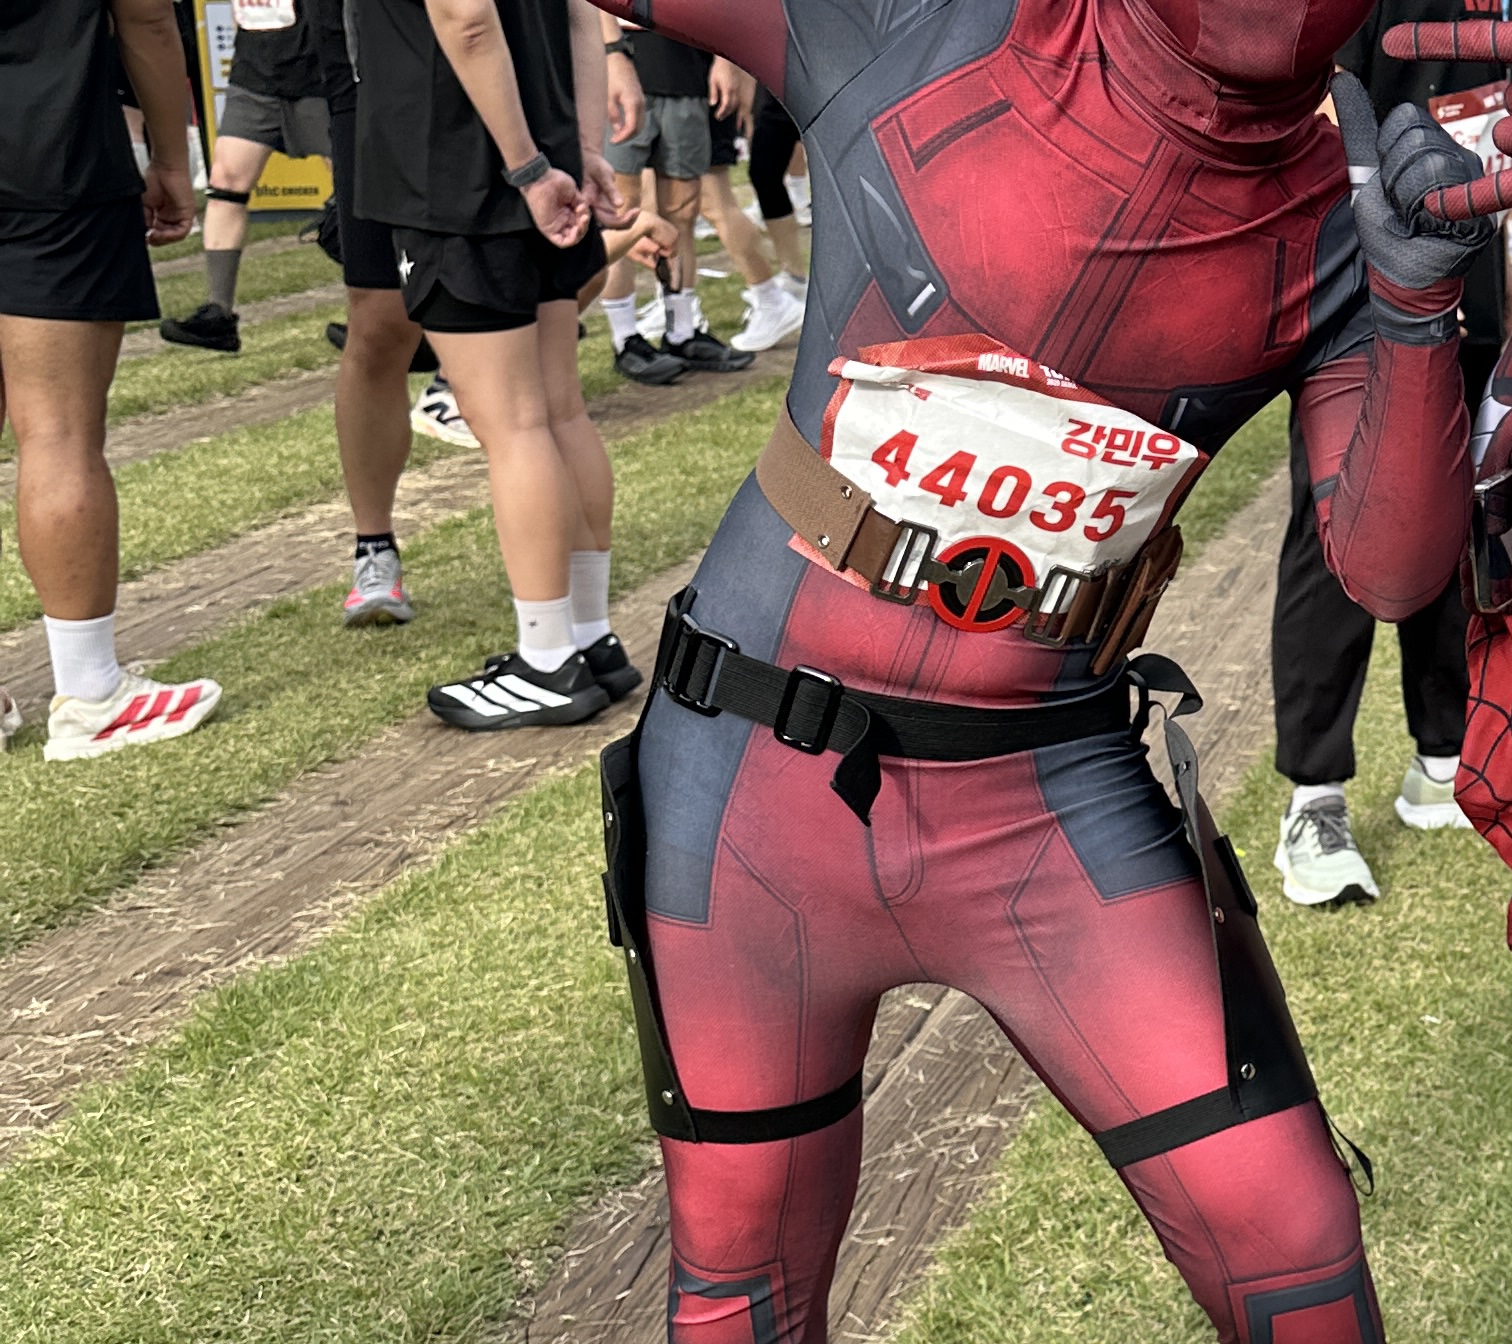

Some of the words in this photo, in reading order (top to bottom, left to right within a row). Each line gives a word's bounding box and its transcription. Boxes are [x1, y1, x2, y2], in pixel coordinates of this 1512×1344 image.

[977, 353, 1030, 379] MARVEL
[1061, 418, 1180, 470] 강민우
[871, 429, 1139, 542] 44035
